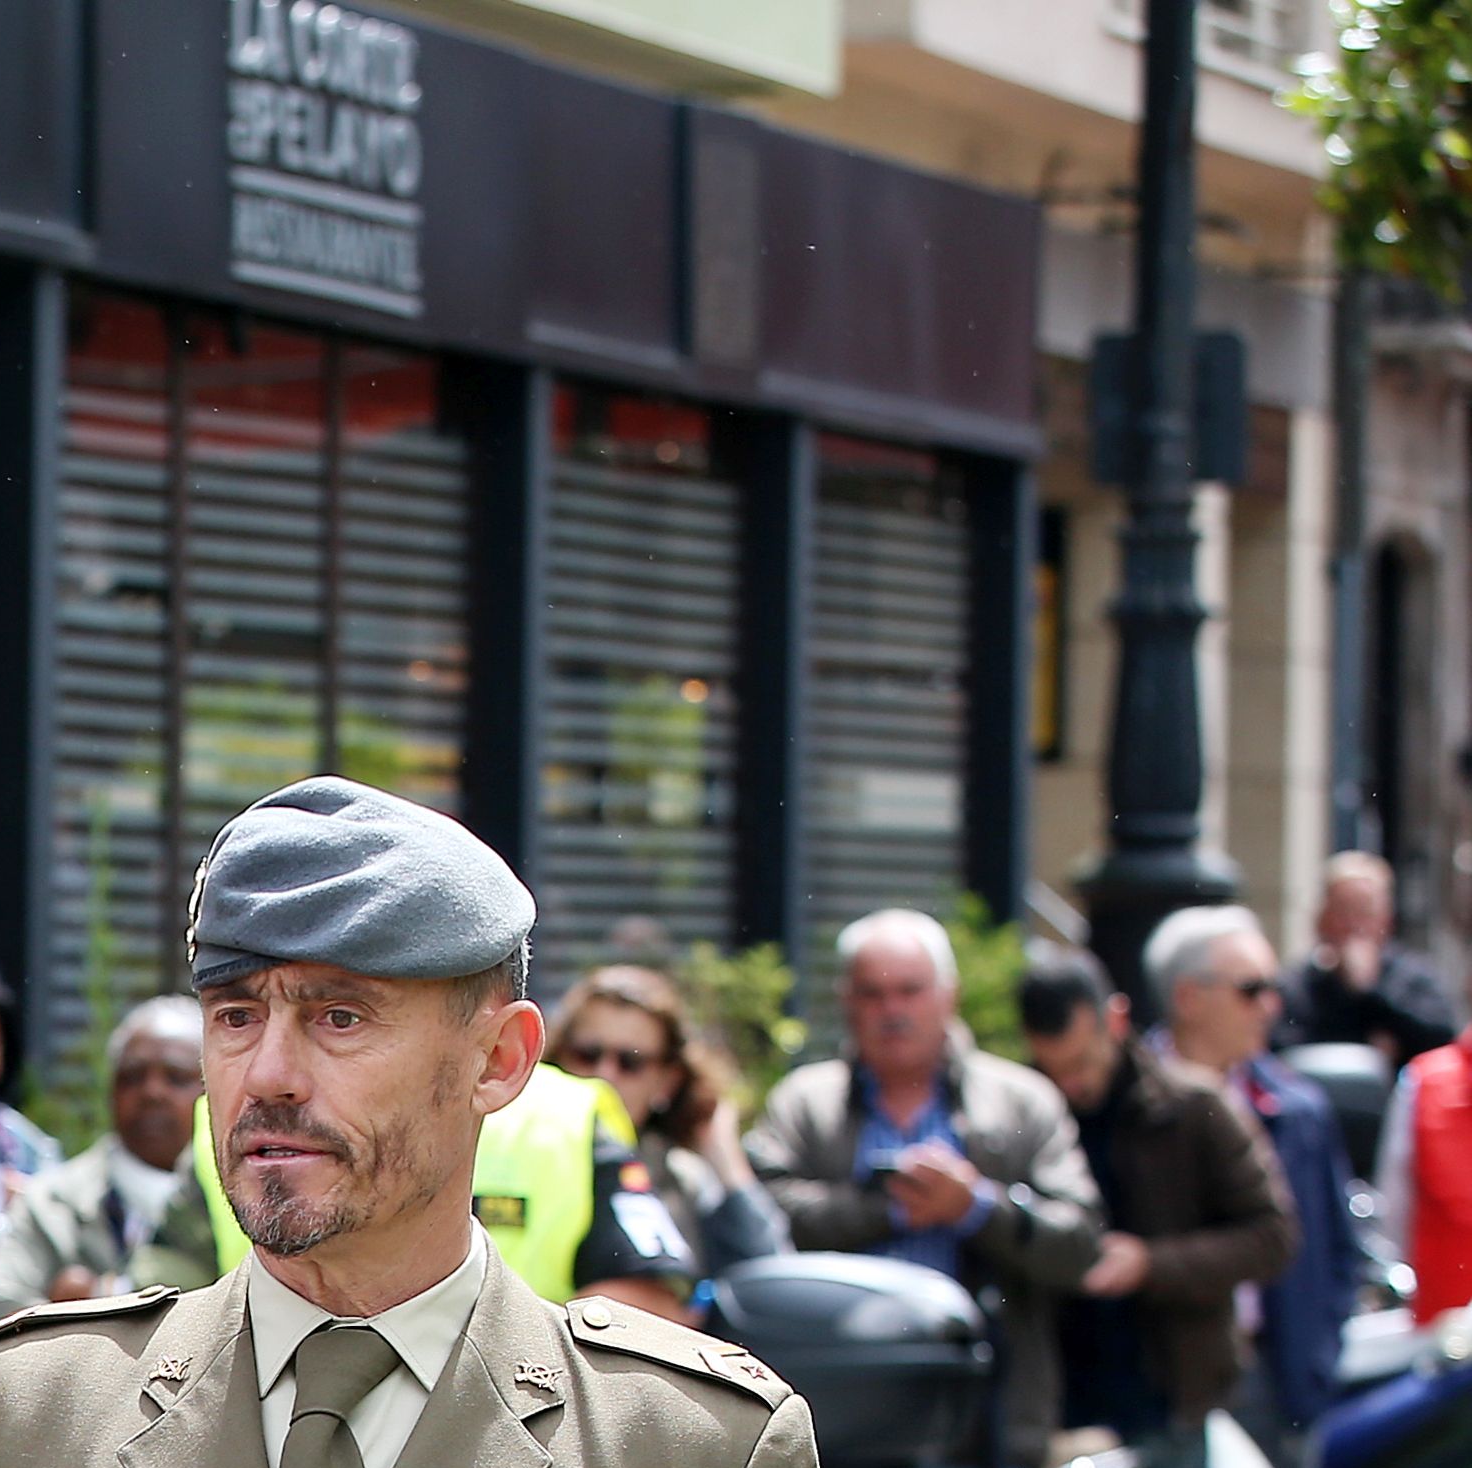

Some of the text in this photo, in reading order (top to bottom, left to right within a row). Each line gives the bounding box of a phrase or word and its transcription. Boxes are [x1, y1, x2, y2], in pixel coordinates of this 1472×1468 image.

[228, 0, 423, 111] LA CORTE
[248, 80, 423, 198] PELAYO
[231, 191, 423, 292] RESTAURANTE
